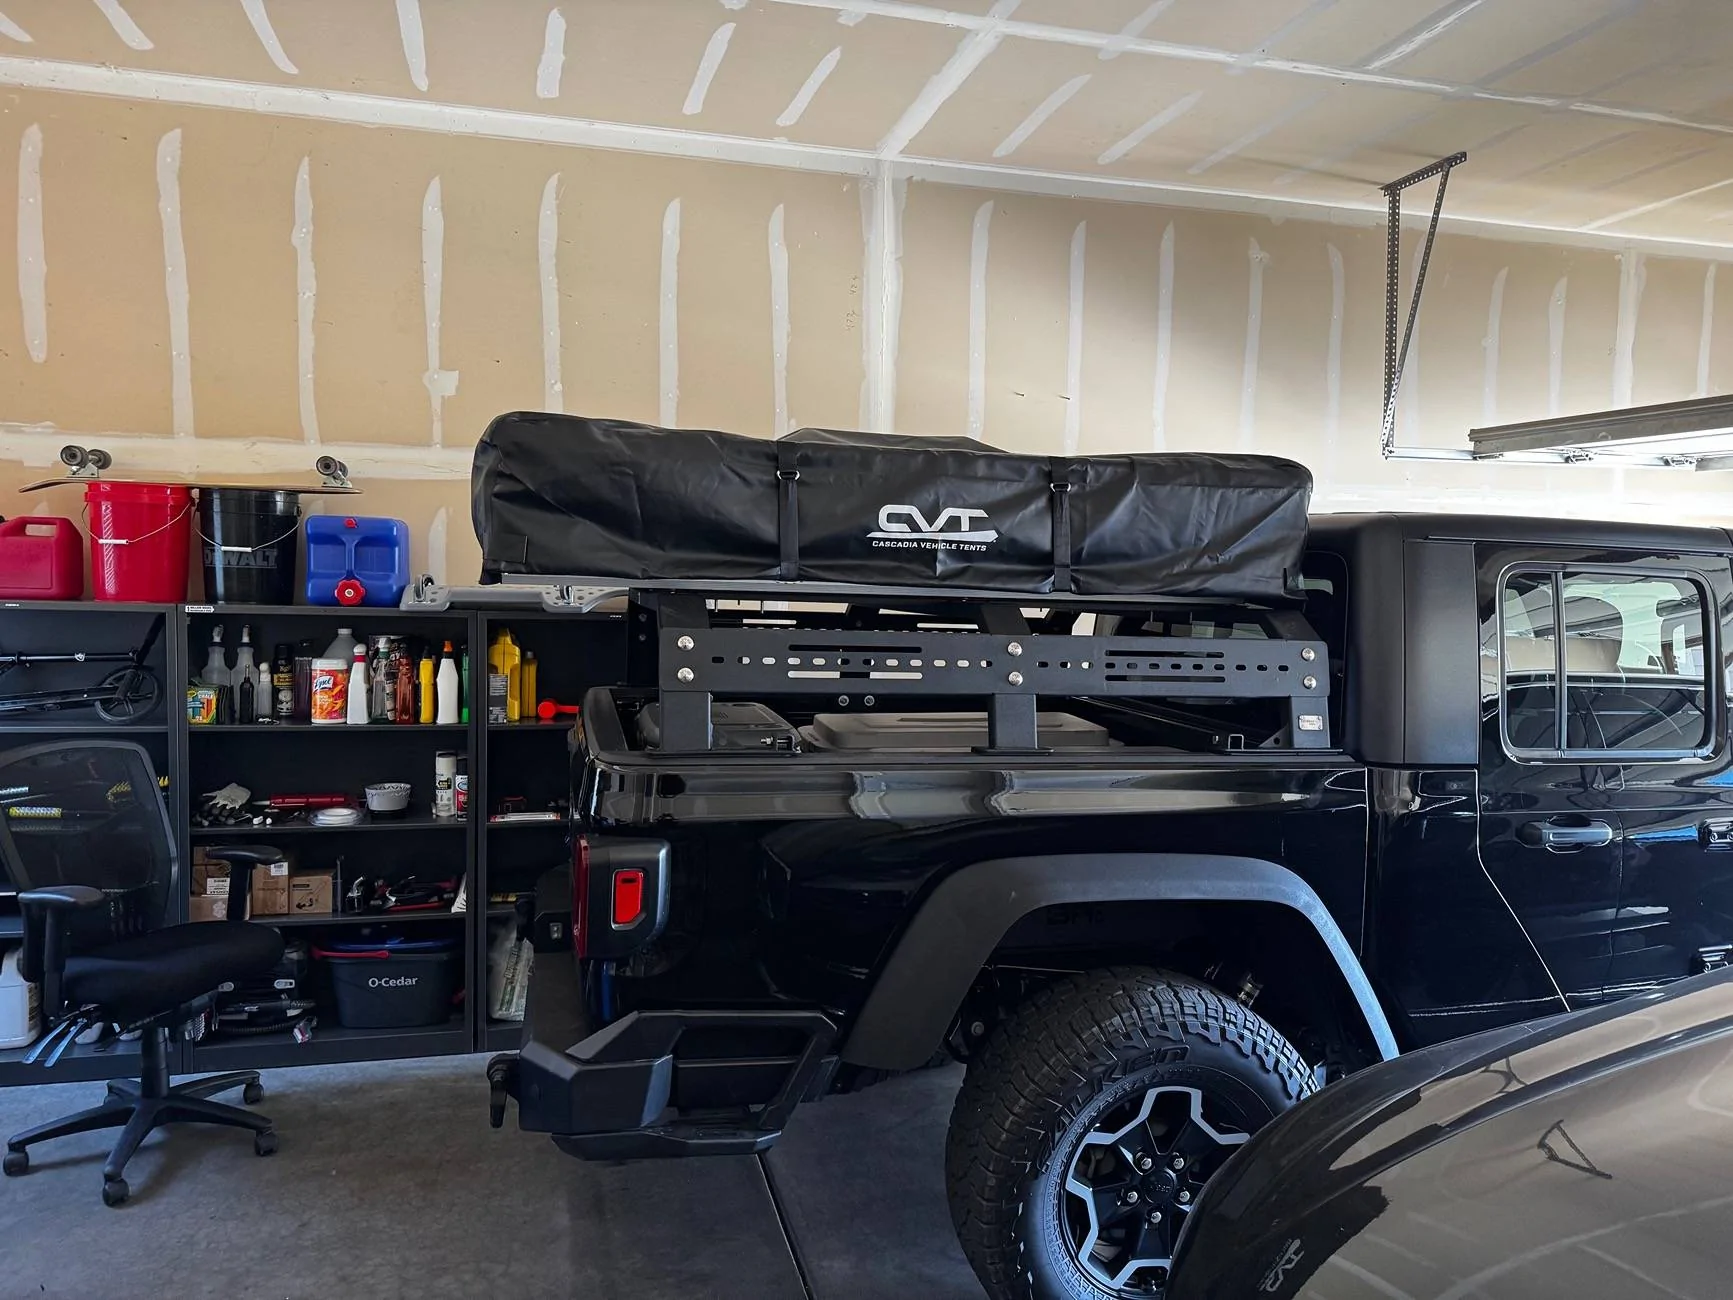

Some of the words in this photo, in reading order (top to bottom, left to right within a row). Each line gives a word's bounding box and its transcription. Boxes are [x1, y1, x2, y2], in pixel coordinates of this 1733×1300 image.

[878, 504, 989, 532] CVT
[872, 540, 918, 548] CASCADIA
[920, 541, 957, 550] VEHICLE
[959, 543, 987, 552] TENTS
[368, 976, 418, 988] O-Cedar
